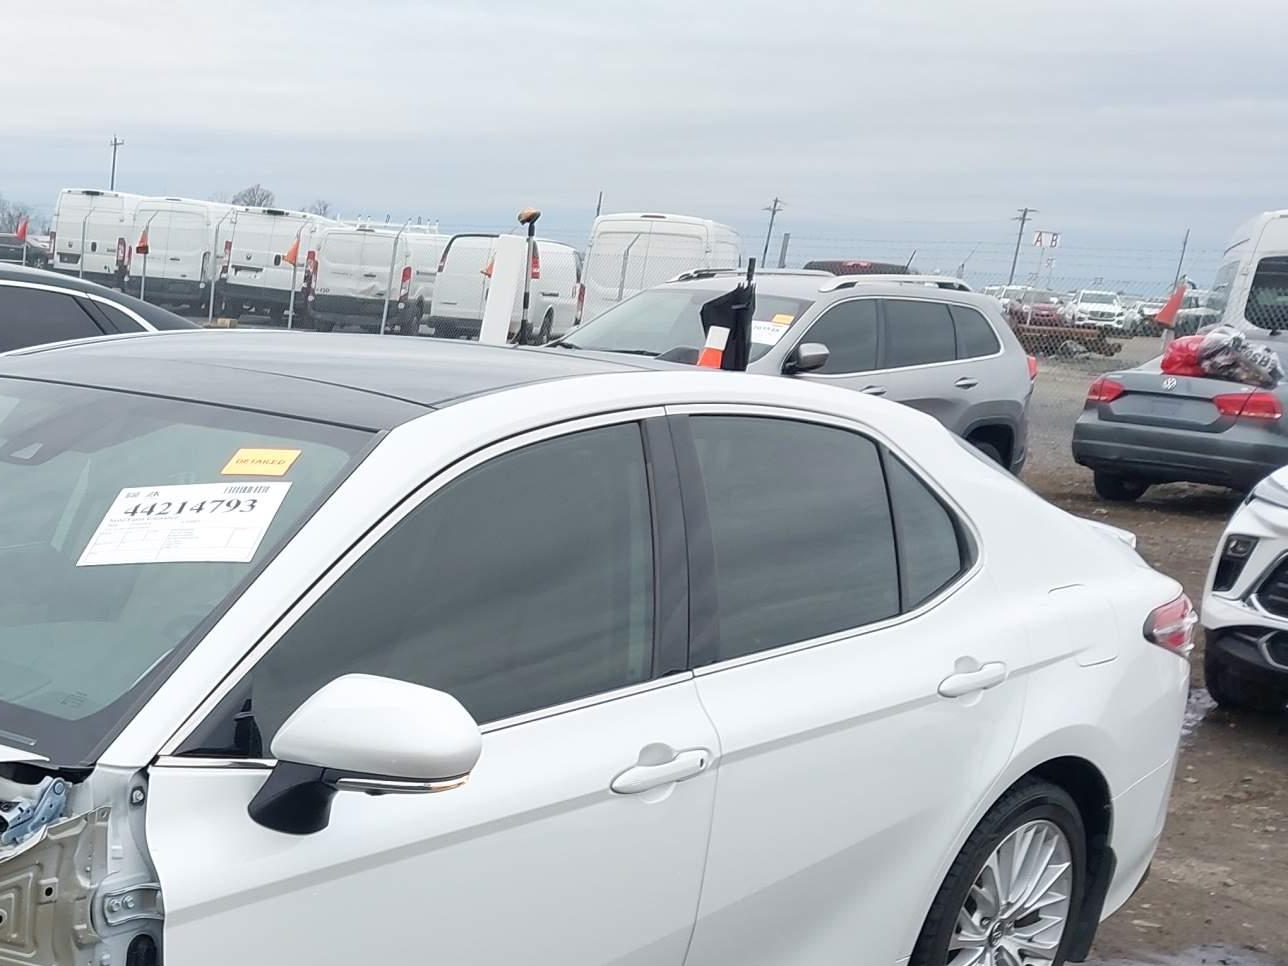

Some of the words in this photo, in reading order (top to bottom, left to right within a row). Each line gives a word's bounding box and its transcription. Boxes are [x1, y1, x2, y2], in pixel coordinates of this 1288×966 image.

[1033, 231, 1043, 248] A
[1049, 232, 1059, 249] B
[123, 499, 258, 517] 44214793
